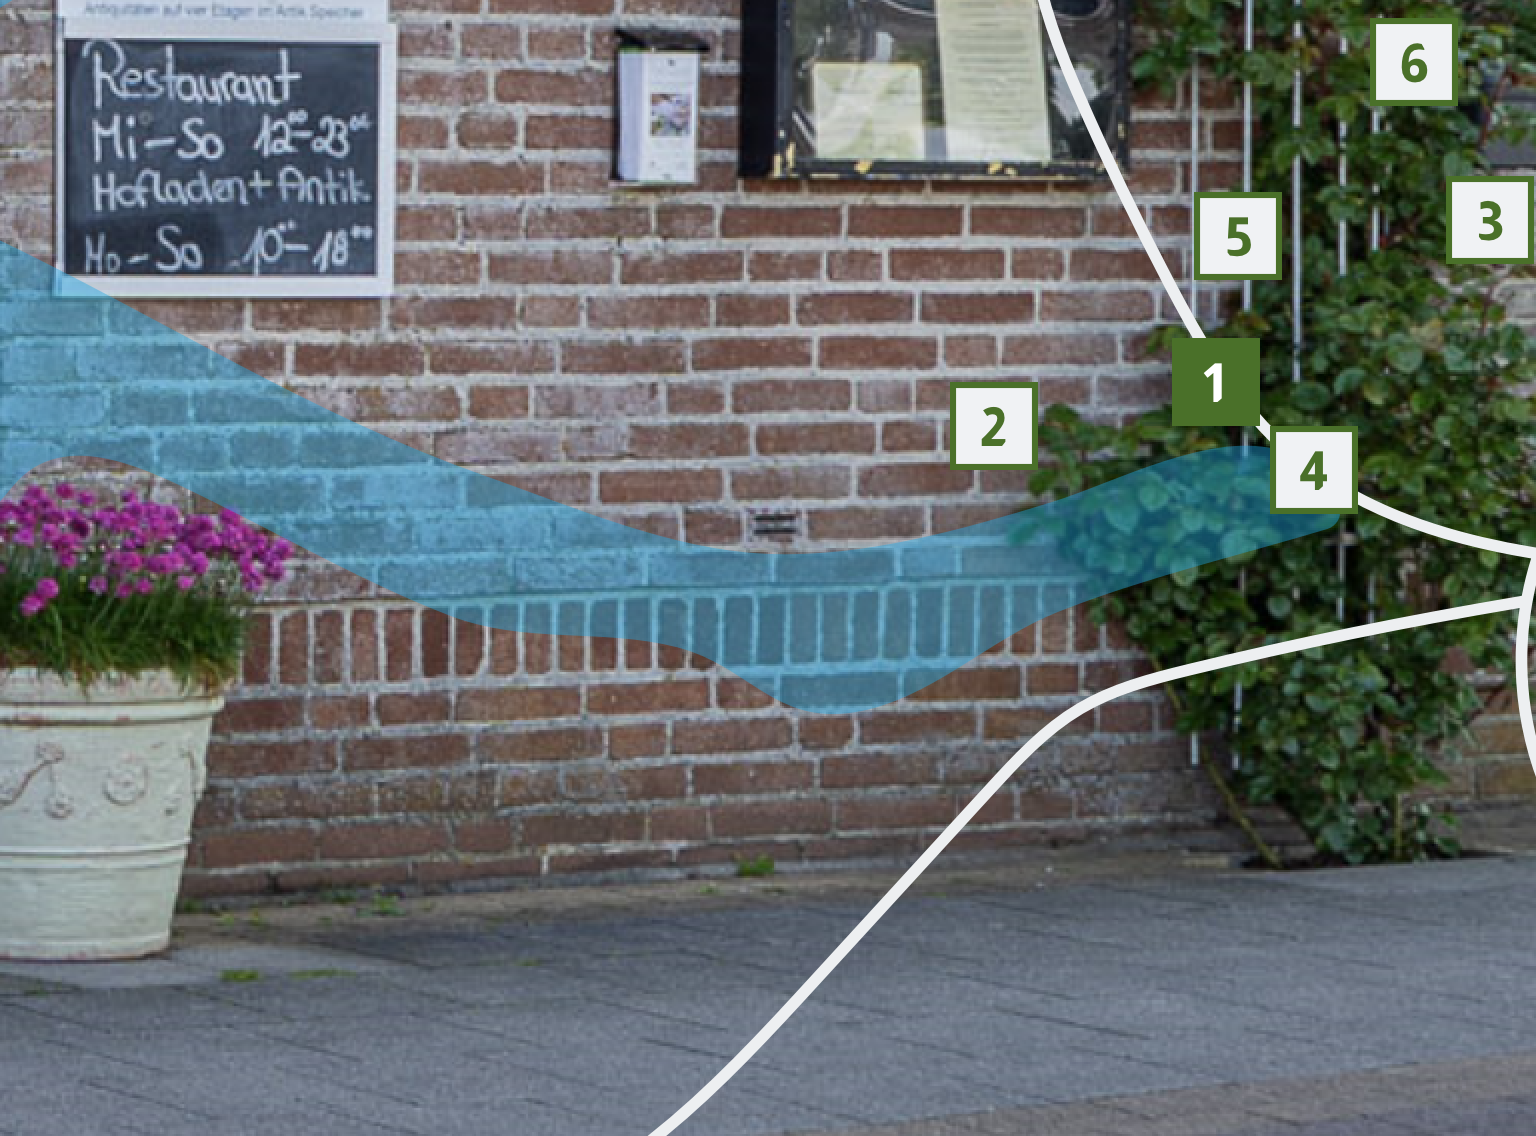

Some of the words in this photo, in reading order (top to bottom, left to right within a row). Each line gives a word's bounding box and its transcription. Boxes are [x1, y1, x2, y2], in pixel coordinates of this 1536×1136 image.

[81, 38, 304, 110] Restaurant
[92, 167, 249, 212] Hofladen
[276, 165, 372, 206] Antik
